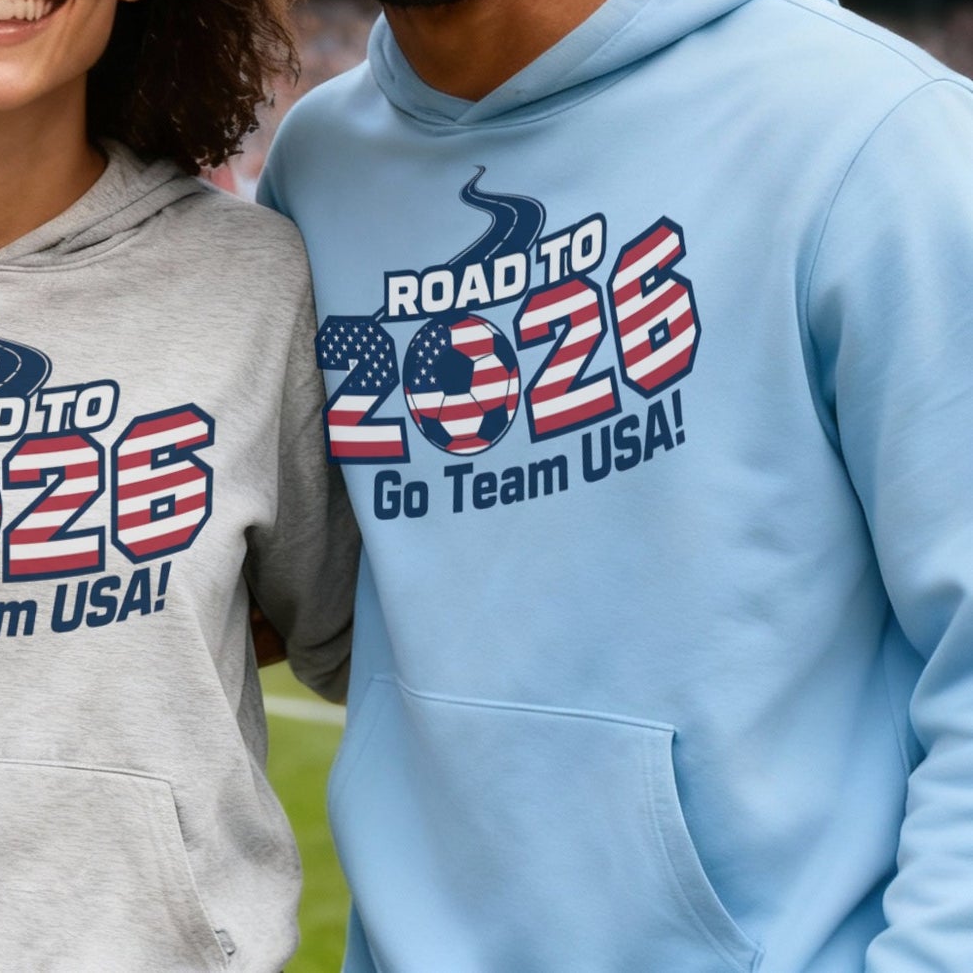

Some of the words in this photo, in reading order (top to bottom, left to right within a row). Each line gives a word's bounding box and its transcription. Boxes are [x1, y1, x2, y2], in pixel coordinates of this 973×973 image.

[386, 251, 528, 318] ROAD
[538, 215, 604, 285] TO
[314, 215, 701, 465] 2026
[39, 381, 118, 434] TO
[373, 470, 428, 520] Go
[444, 454, 568, 513] Team
[581, 389, 685, 482] USA!
[51, 562, 172, 633] USA!
